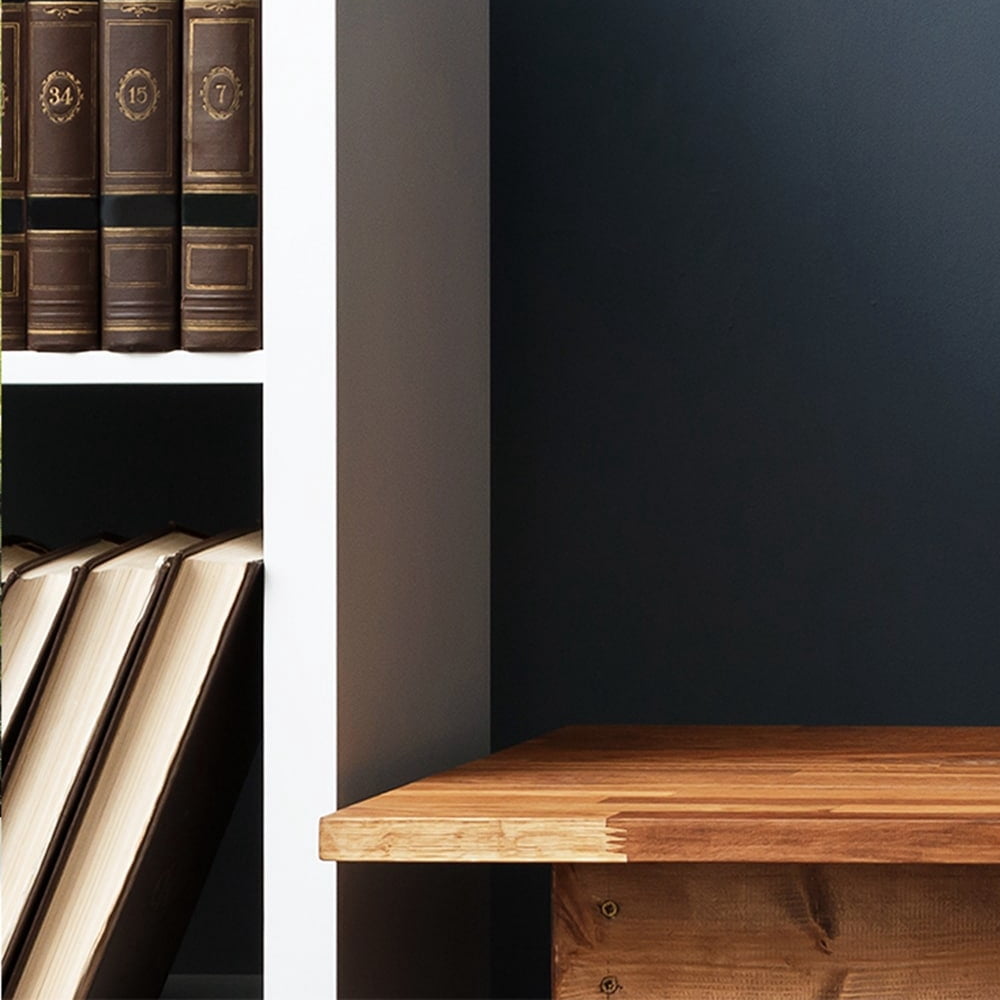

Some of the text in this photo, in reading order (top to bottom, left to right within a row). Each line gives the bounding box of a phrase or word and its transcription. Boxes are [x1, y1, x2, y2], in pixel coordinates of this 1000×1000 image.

[48, 85, 74, 106] 34
[127, 85, 148, 105] 15
[215, 84, 227, 104] 7
